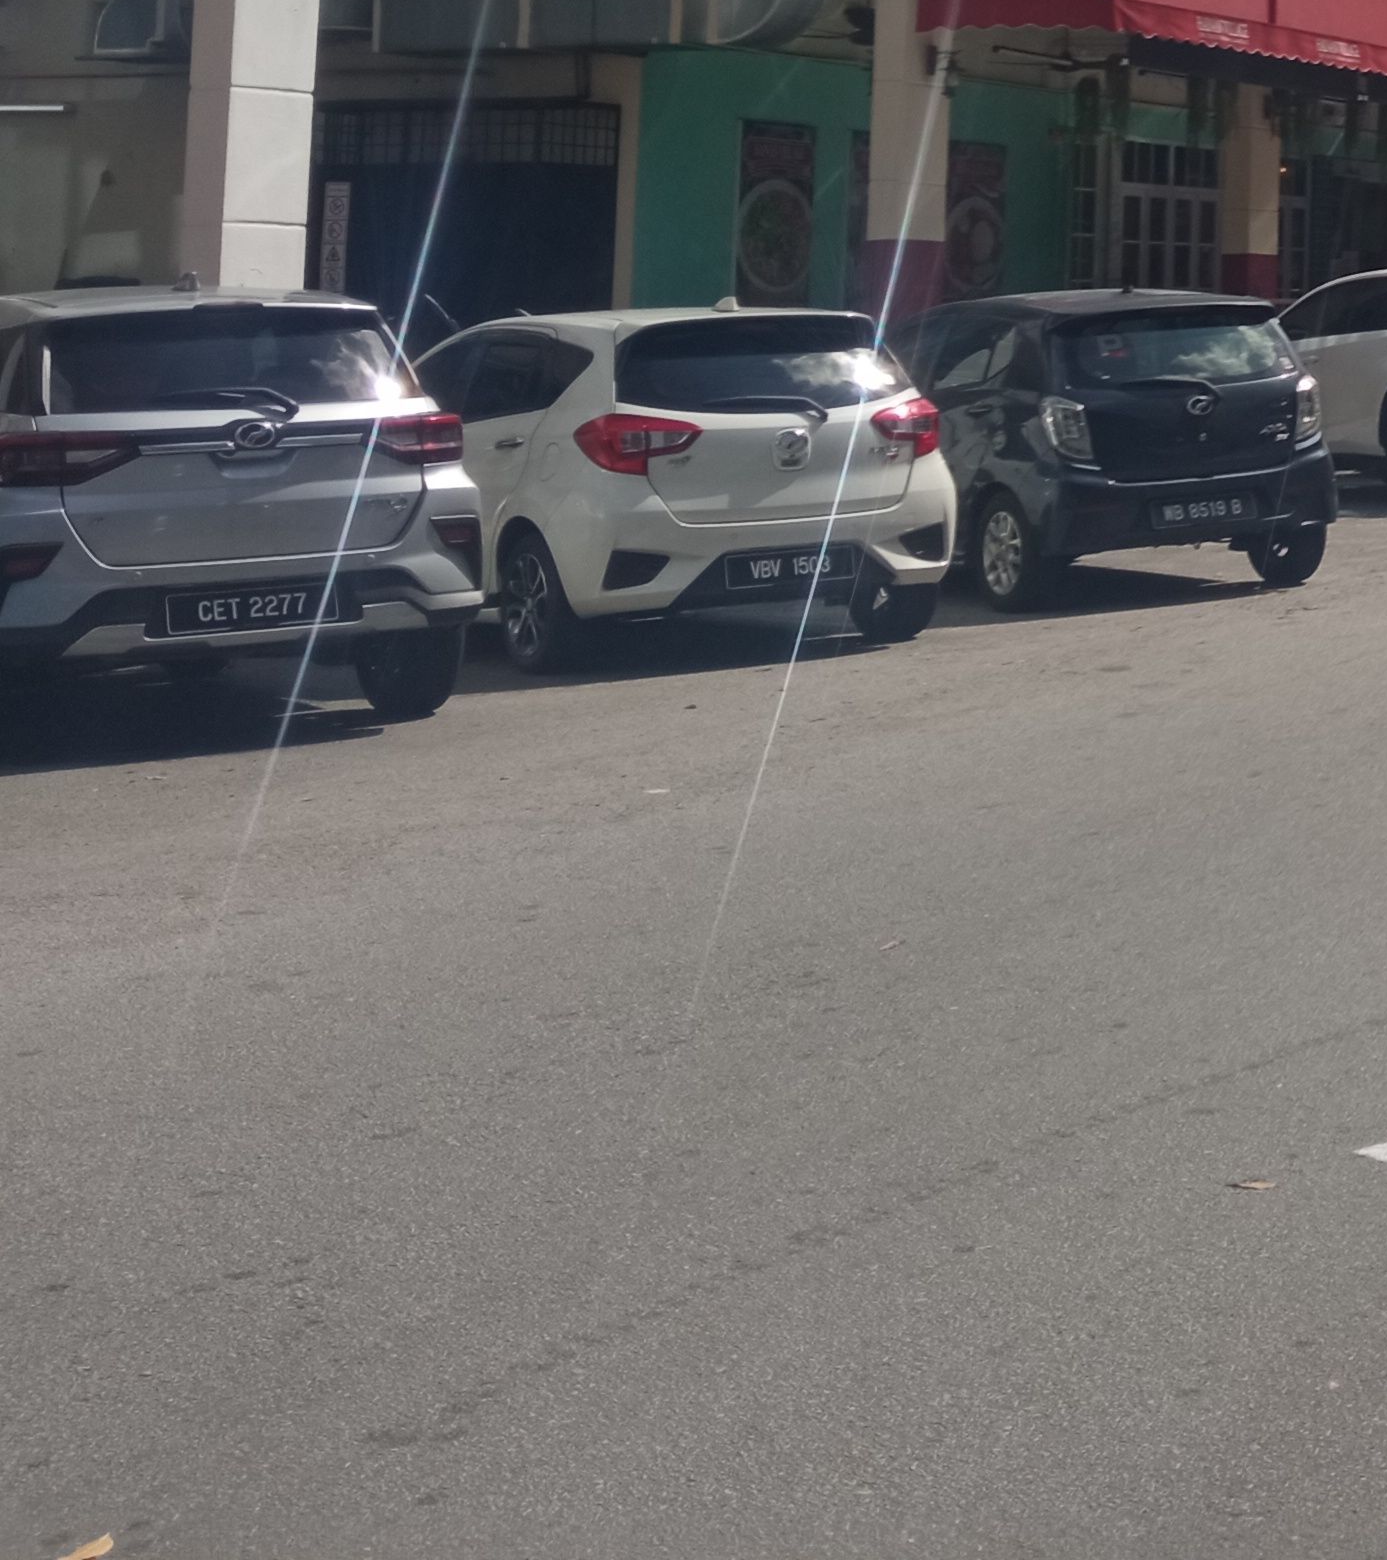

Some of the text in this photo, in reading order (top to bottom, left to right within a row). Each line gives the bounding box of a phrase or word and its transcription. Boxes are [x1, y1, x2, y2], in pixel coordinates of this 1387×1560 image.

[750, 559, 782, 579] VBV
[198, 592, 307, 622] CET 2277
